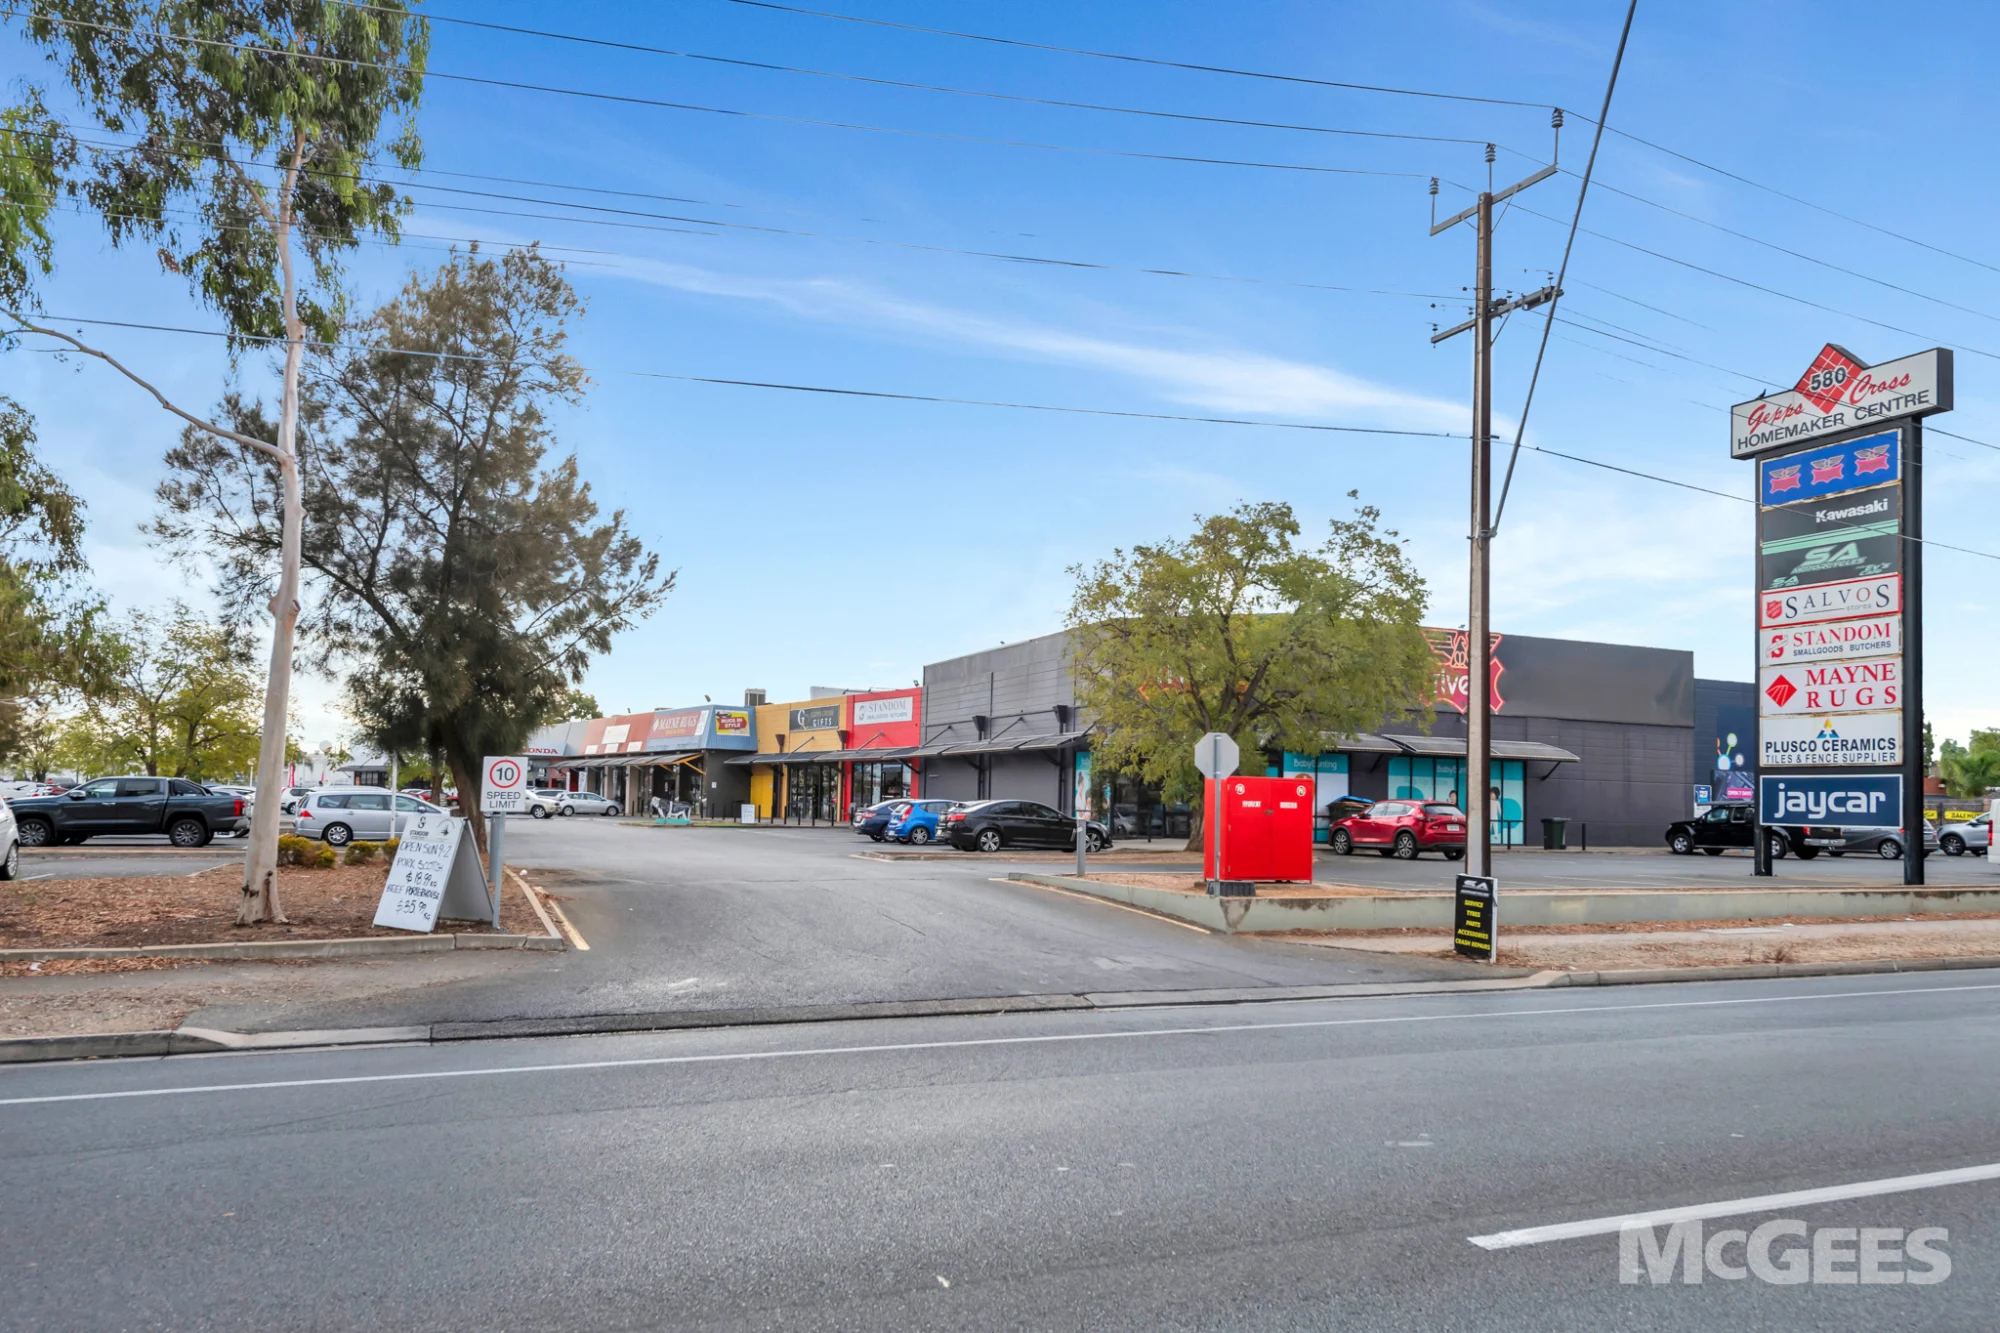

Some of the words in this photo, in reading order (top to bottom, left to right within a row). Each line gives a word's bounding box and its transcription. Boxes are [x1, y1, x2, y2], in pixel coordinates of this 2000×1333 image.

[1810, 366, 1847, 392] 580
[1747, 402, 1804, 434] Gepps
[1850, 373, 1912, 404] Cross
[1738, 413, 1845, 449] HOMEMAKER
[1854, 389, 1930, 420] CENTRE
[1816, 498, 1889, 523] Kawasaki
[1803, 542, 1860, 565] SA
[1785, 584, 1890, 619] SALVOS
[1793, 622, 1891, 648] STANDOM
[1793, 645, 1844, 657] SMALLGOODS
[1850, 640, 1892, 651] BUTCHERS
[1805, 662, 1896, 687] MAYNE
[1806, 685, 1897, 709] RUGS
[868, 700, 906, 713] STANDOM
[659, 716, 680, 729] MAYNE
[680, 714, 698, 728] RUGS
[812, 717, 832, 728] GIFTS
[1765, 739, 1817, 753] PLUSCO
[1822, 738, 1896, 752] CERAMICS
[1766, 754, 1793, 764] TILES
[1796, 754, 1802, 763] &
[1805, 753, 1838, 763] FENCE
[1842, 752, 1896, 763] SUPPLIER
[496, 767, 515, 781] 10
[486, 791, 521, 800] SPEED
[1774, 782, 1886, 819] jaycar
[489, 800, 517, 809] LIMIT
[400, 840, 422, 853] OPEN
[422, 843, 438, 855] SUN
[396, 857, 416, 869] PORK
[386, 883, 404, 894] BEEF
[1462, 880, 1489, 892] SA
[1464, 899, 1483, 908] SERVICE
[1466, 910, 1481, 918] TYRES
[1466, 920, 1481, 928] PARTS
[1457, 928, 1489, 939] ACCESSORIES
[1455, 938, 1471, 947] CRASH
[1471, 941, 1490, 951] REPAIRS
